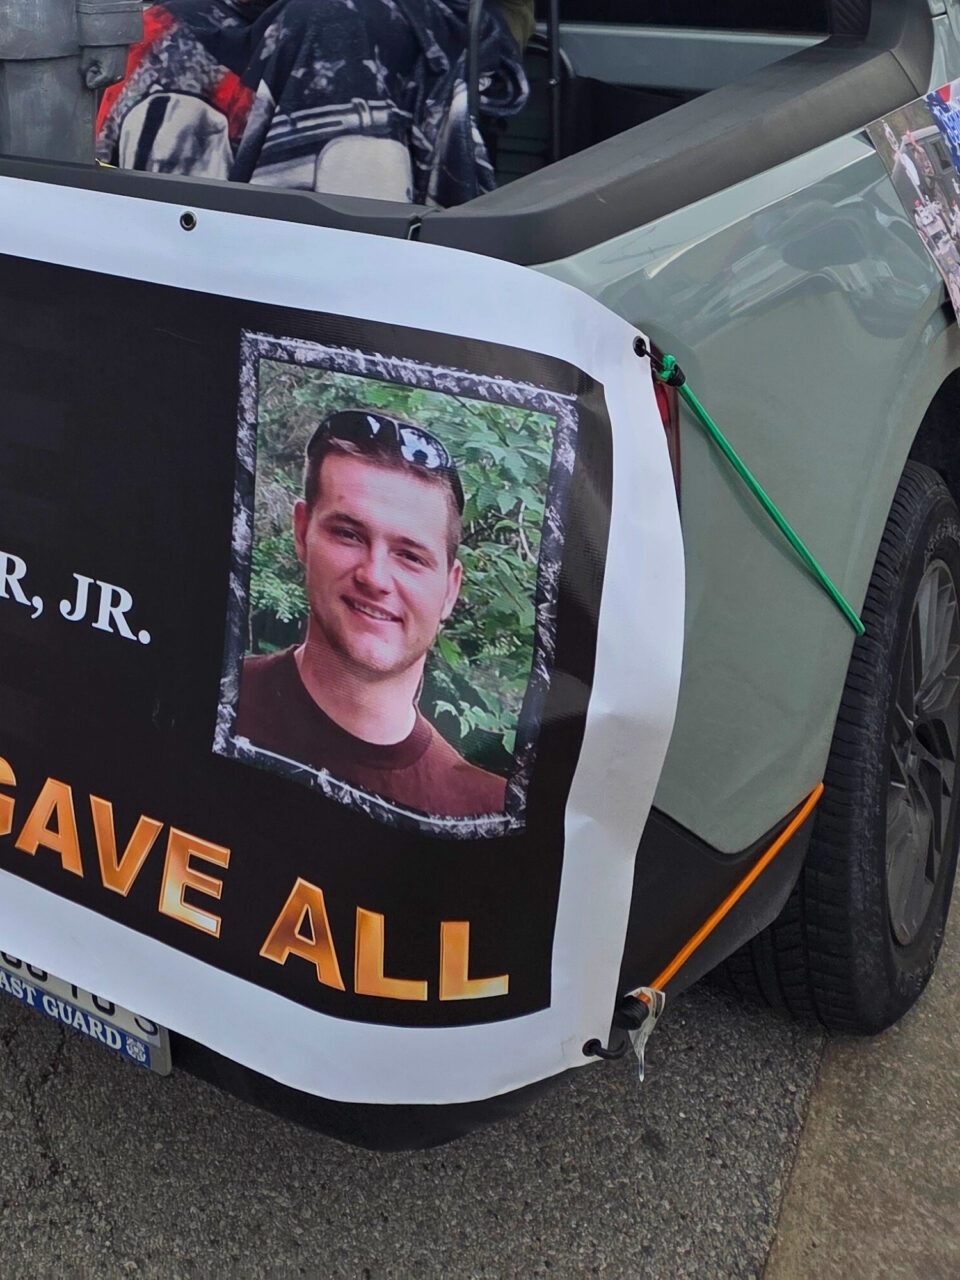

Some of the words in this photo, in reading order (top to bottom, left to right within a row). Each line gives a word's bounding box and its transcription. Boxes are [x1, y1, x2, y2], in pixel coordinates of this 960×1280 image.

[58, 573, 153, 645] JR.
[258, 875, 511, 1002] ALL
[42, 993, 123, 1051] GUARD
